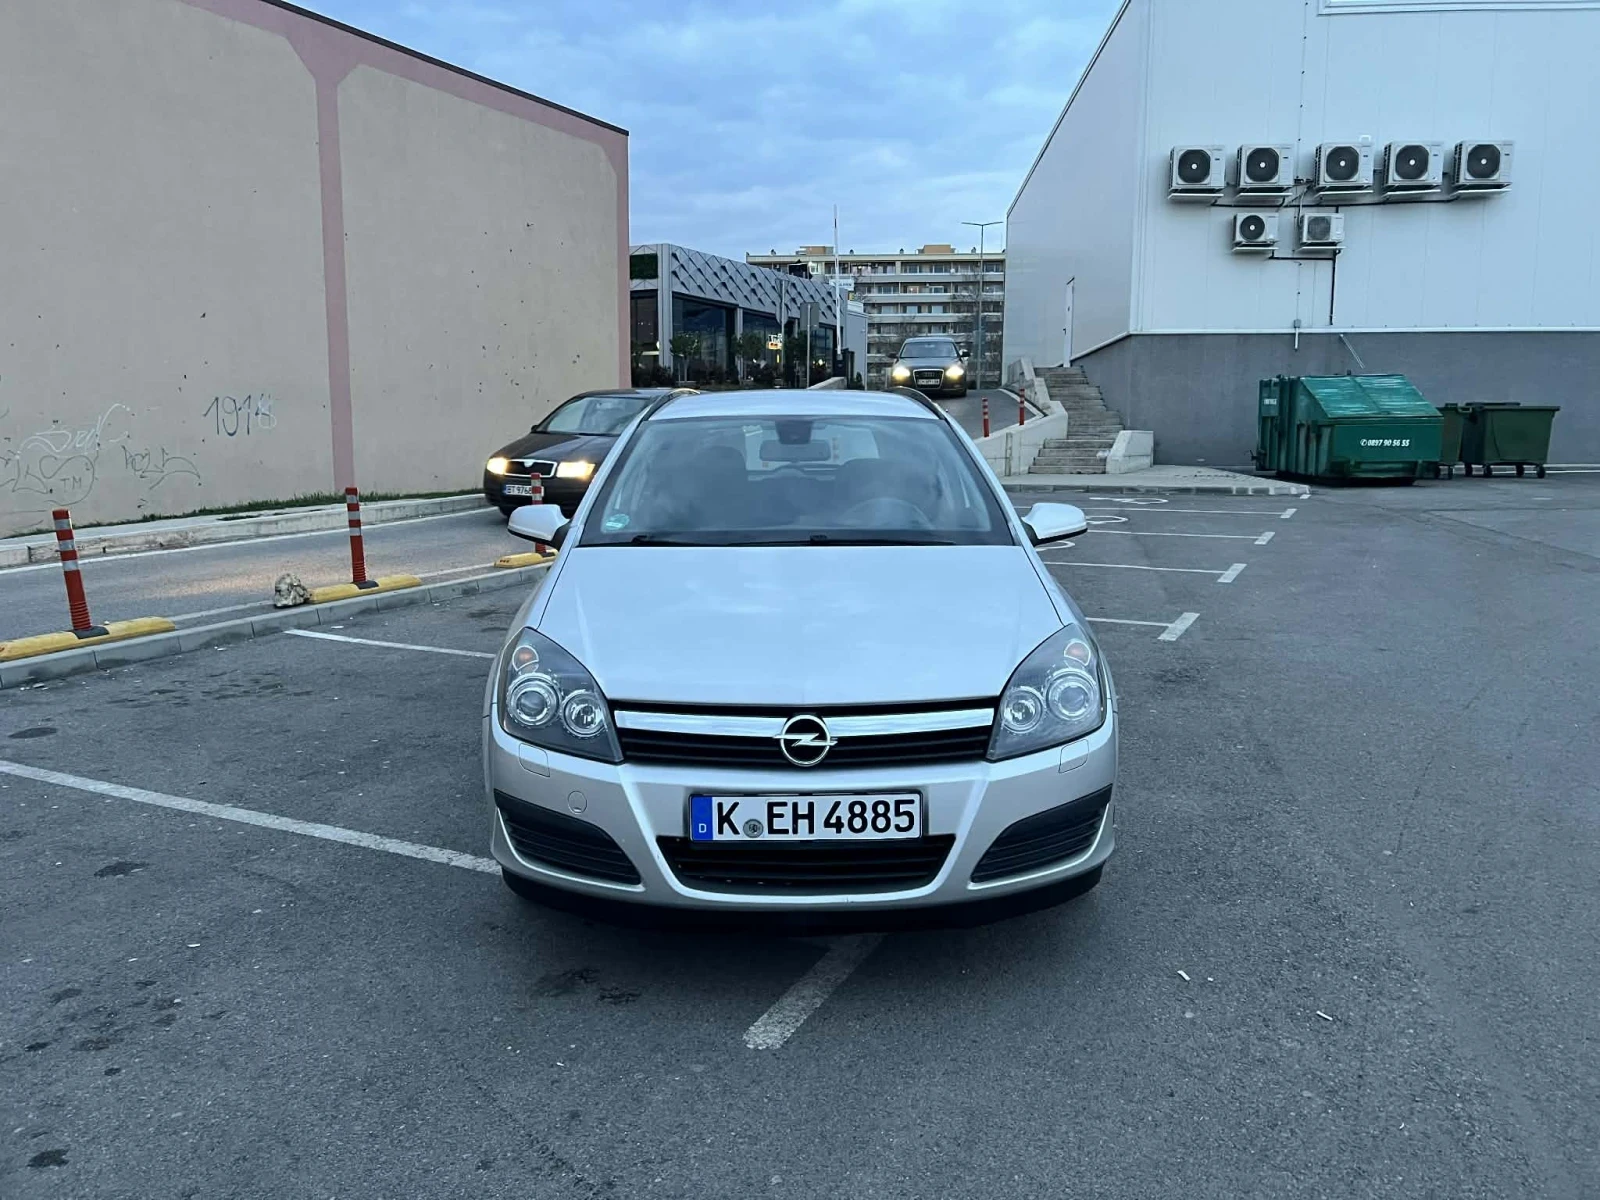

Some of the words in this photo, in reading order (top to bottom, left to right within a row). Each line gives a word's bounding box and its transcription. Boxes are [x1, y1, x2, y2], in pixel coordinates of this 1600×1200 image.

[1383, 439, 1392, 447] 90
[1392, 439, 1401, 447] 56
[1401, 439, 1410, 447] 55
[716, 801, 741, 836] K
[766, 801, 816, 836] EH
[823, 799, 916, 835] 4885
[698, 823, 707, 833] D
